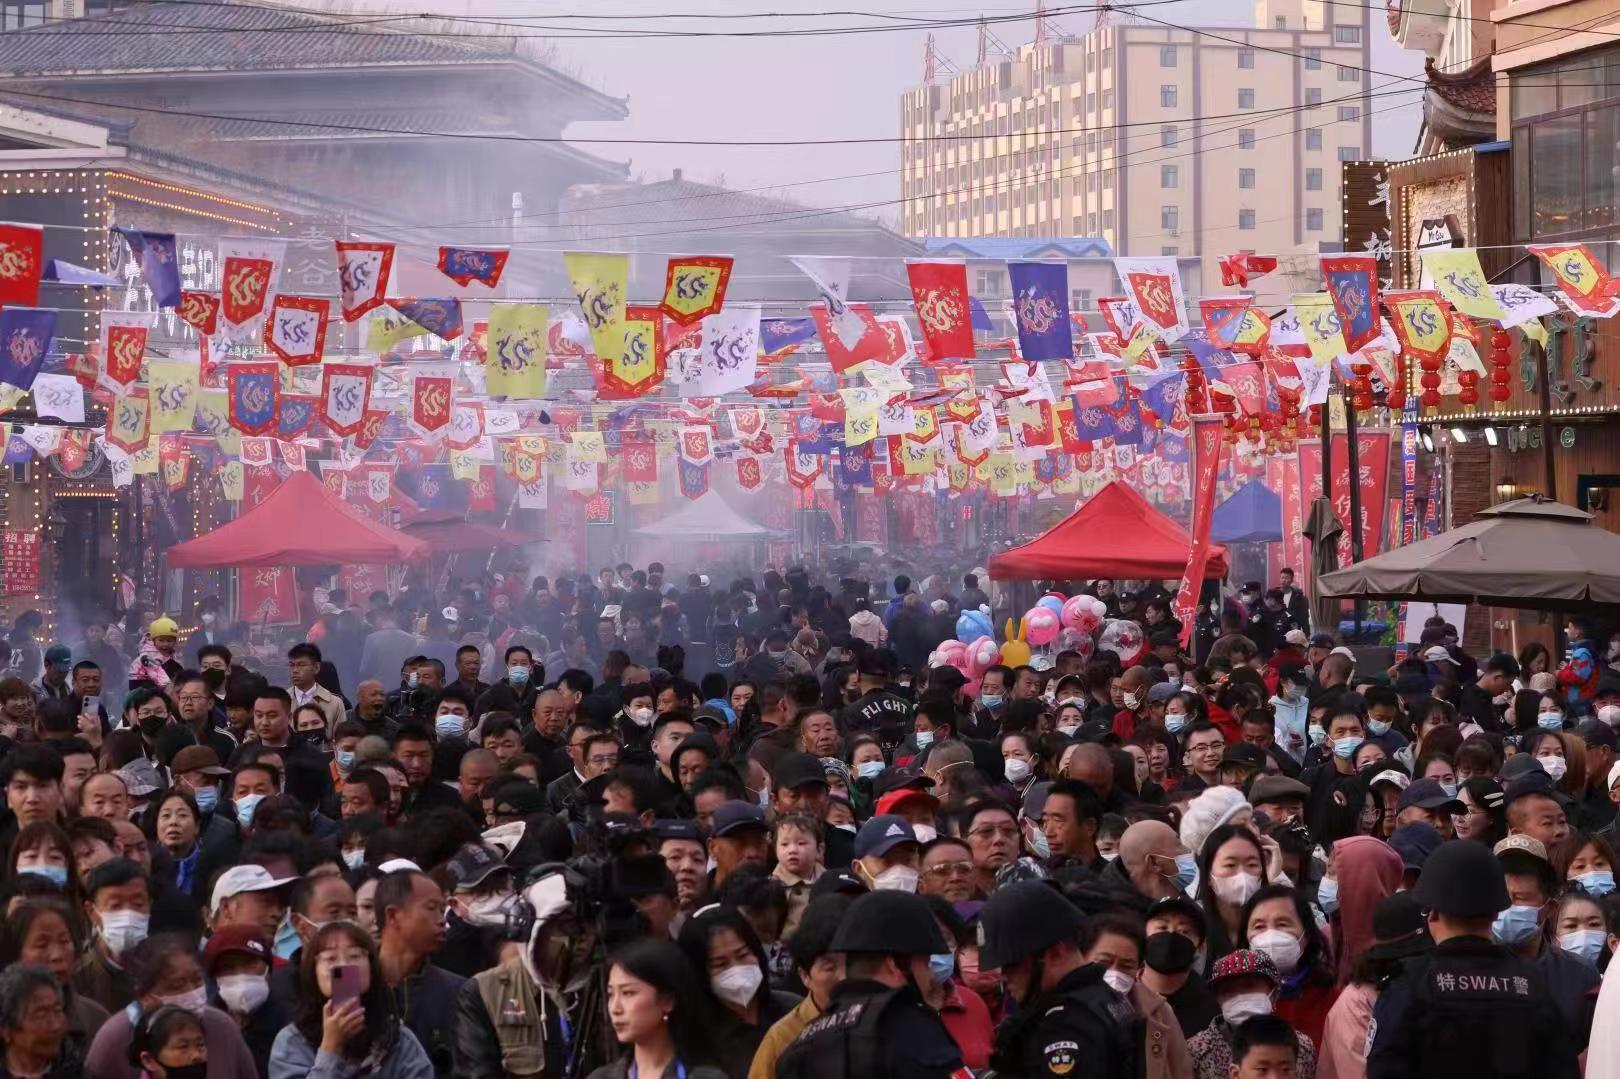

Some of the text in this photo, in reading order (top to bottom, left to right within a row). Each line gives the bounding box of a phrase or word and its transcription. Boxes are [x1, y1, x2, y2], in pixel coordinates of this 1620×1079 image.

[5, 532, 36, 544] 招聘
[861, 699, 908, 719] FLIGHT
[1436, 972, 1529, 996] 特SWAT警
